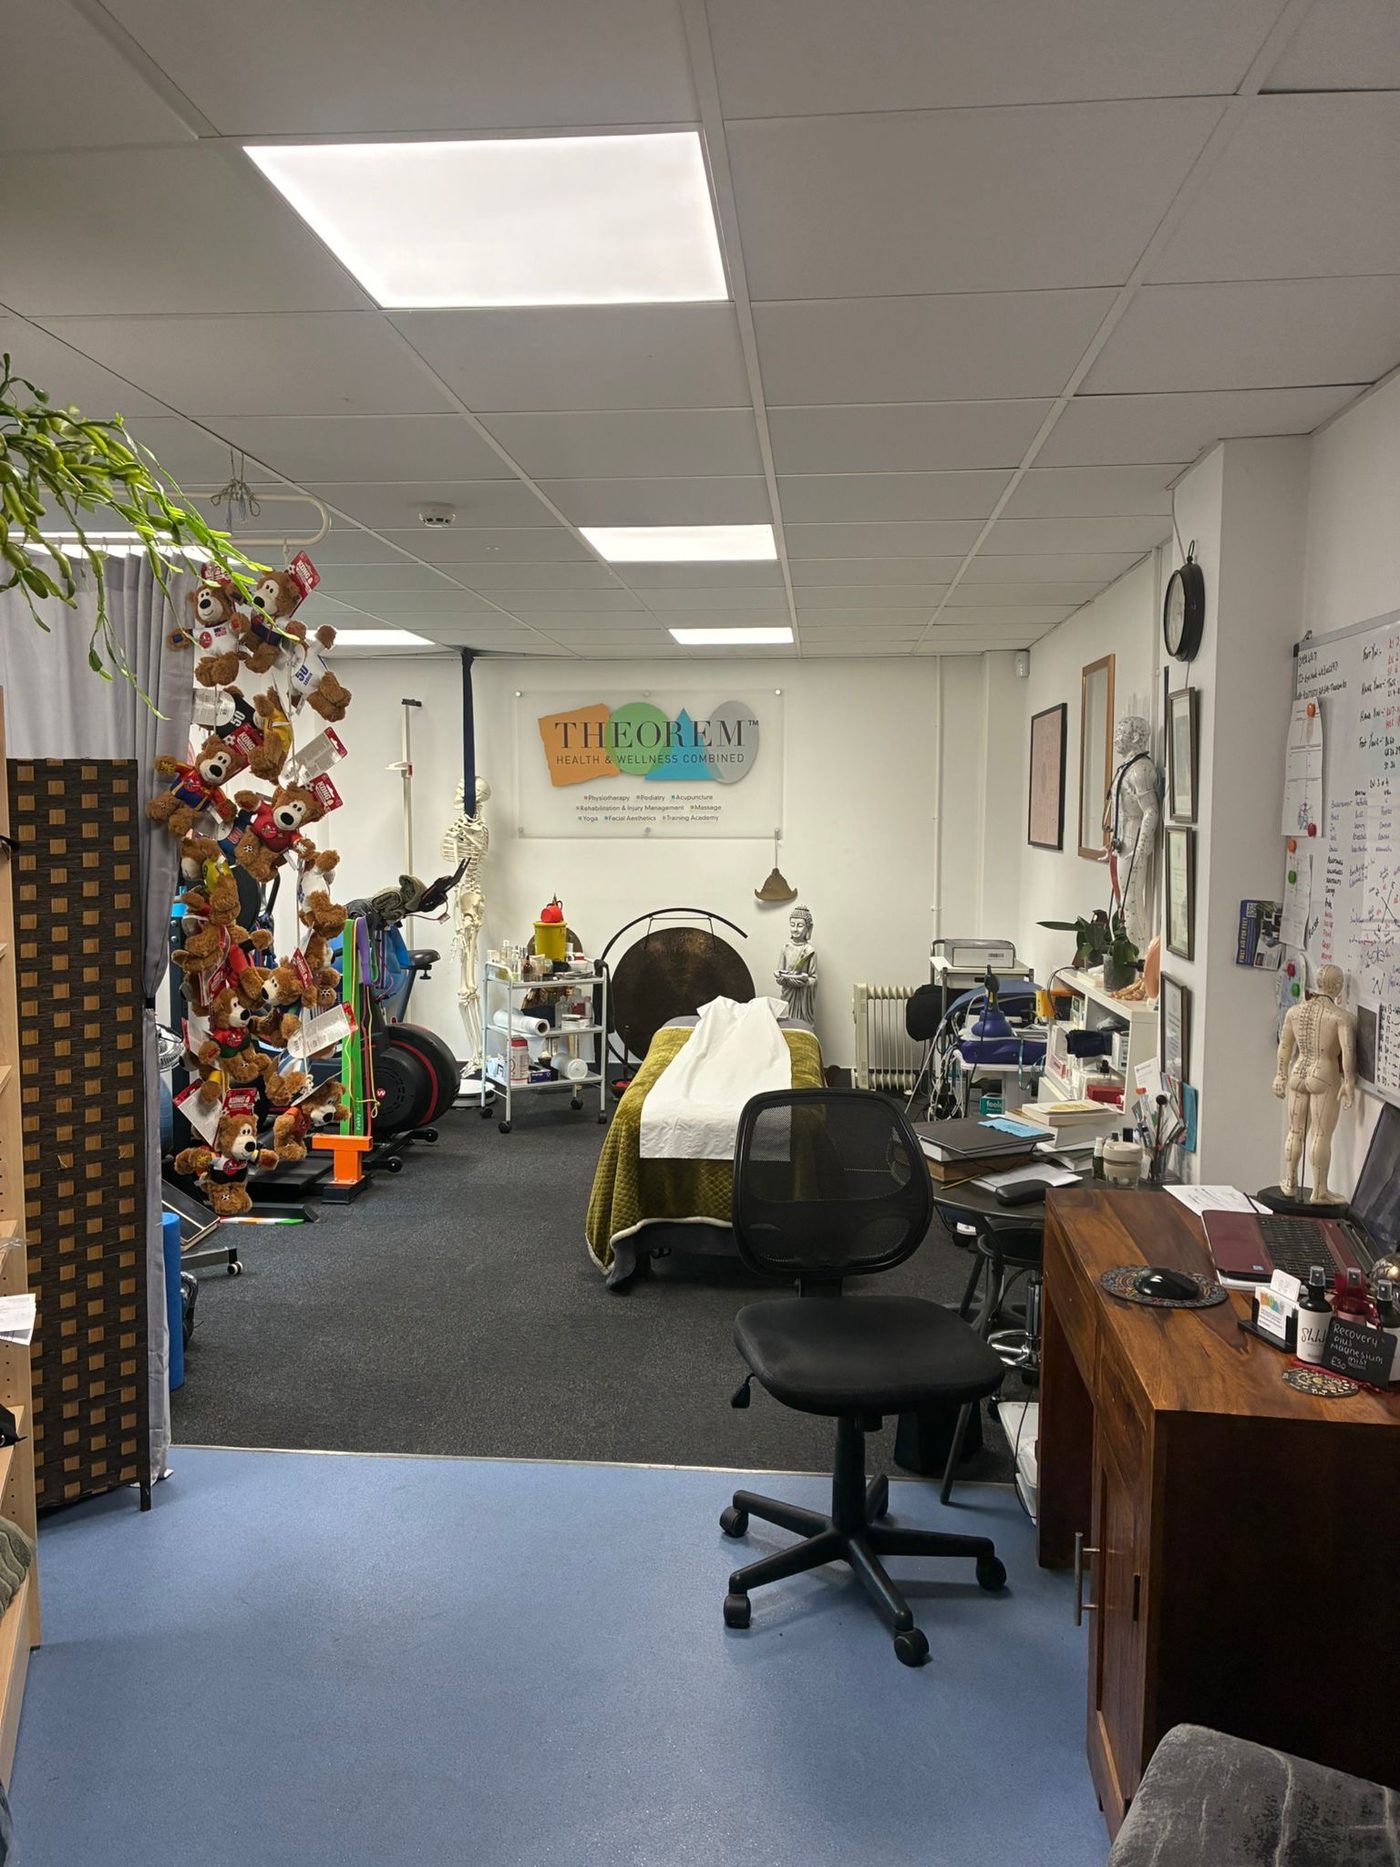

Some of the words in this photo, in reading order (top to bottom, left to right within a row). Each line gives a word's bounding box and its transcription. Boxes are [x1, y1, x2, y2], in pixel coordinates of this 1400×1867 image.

[556, 755, 600, 765] HEALTH
[604, 755, 612, 764] &
[616, 753, 679, 765] WELLNESS
[682, 752, 745, 764] COMBINED
[694, 804, 722, 812] Massage
[666, 814, 690, 822] Training
[690, 814, 719, 822] Academy
[1333, 1323, 1378, 1348] Recovery
